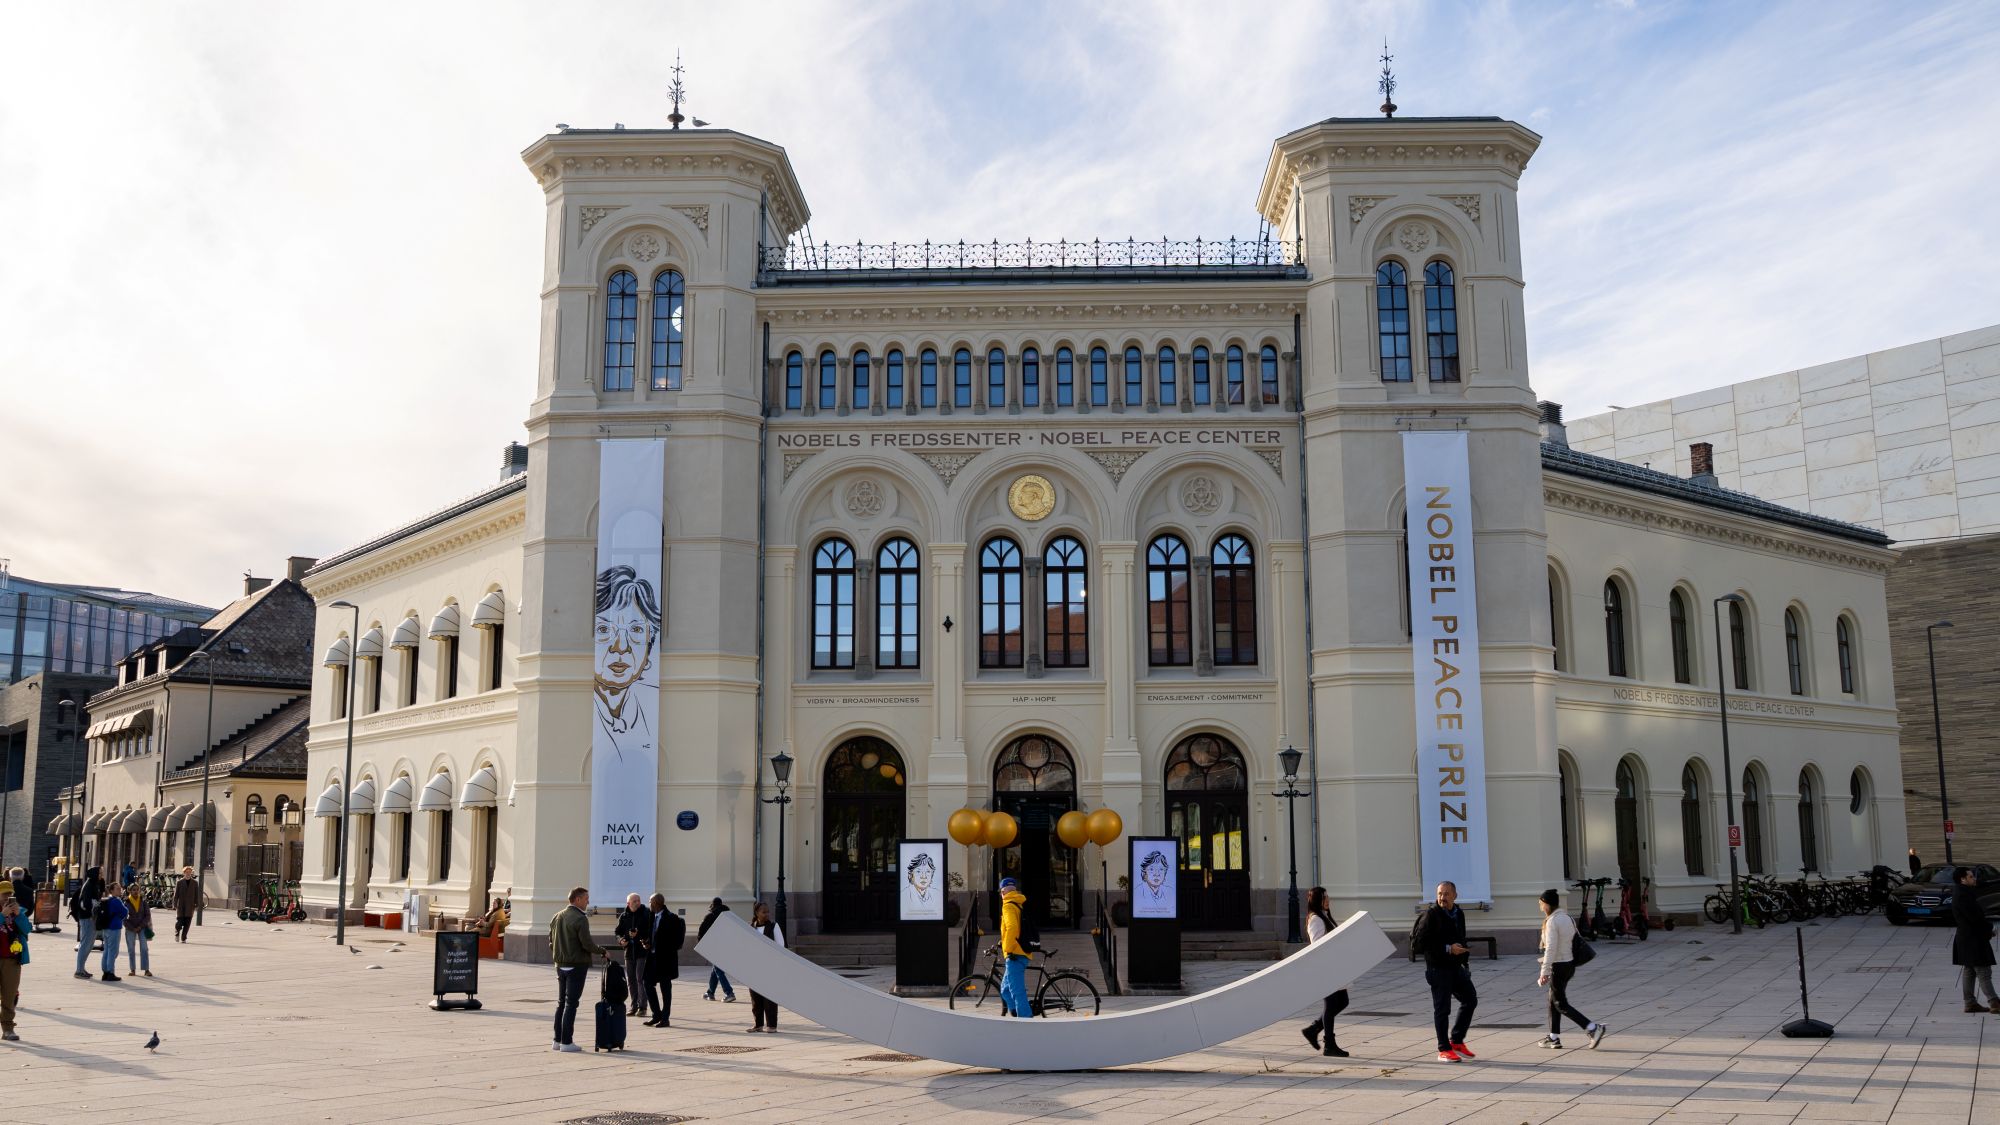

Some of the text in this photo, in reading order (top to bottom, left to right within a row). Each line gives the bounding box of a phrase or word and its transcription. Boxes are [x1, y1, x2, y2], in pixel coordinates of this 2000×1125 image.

[778, 430, 1281, 447] NOBELS FREDSSENTER NOBEL PEACE CENTER
[1425, 487, 1468, 844] NOBEL PEACE PRIZE
[1613, 688, 1815, 716] NOBELS FREDSSENTER NOBEL PEACE CENTER
[607, 823, 640, 833] NAVI
[602, 835, 645, 845] PILLAY
[612, 858, 634, 867] 2026
